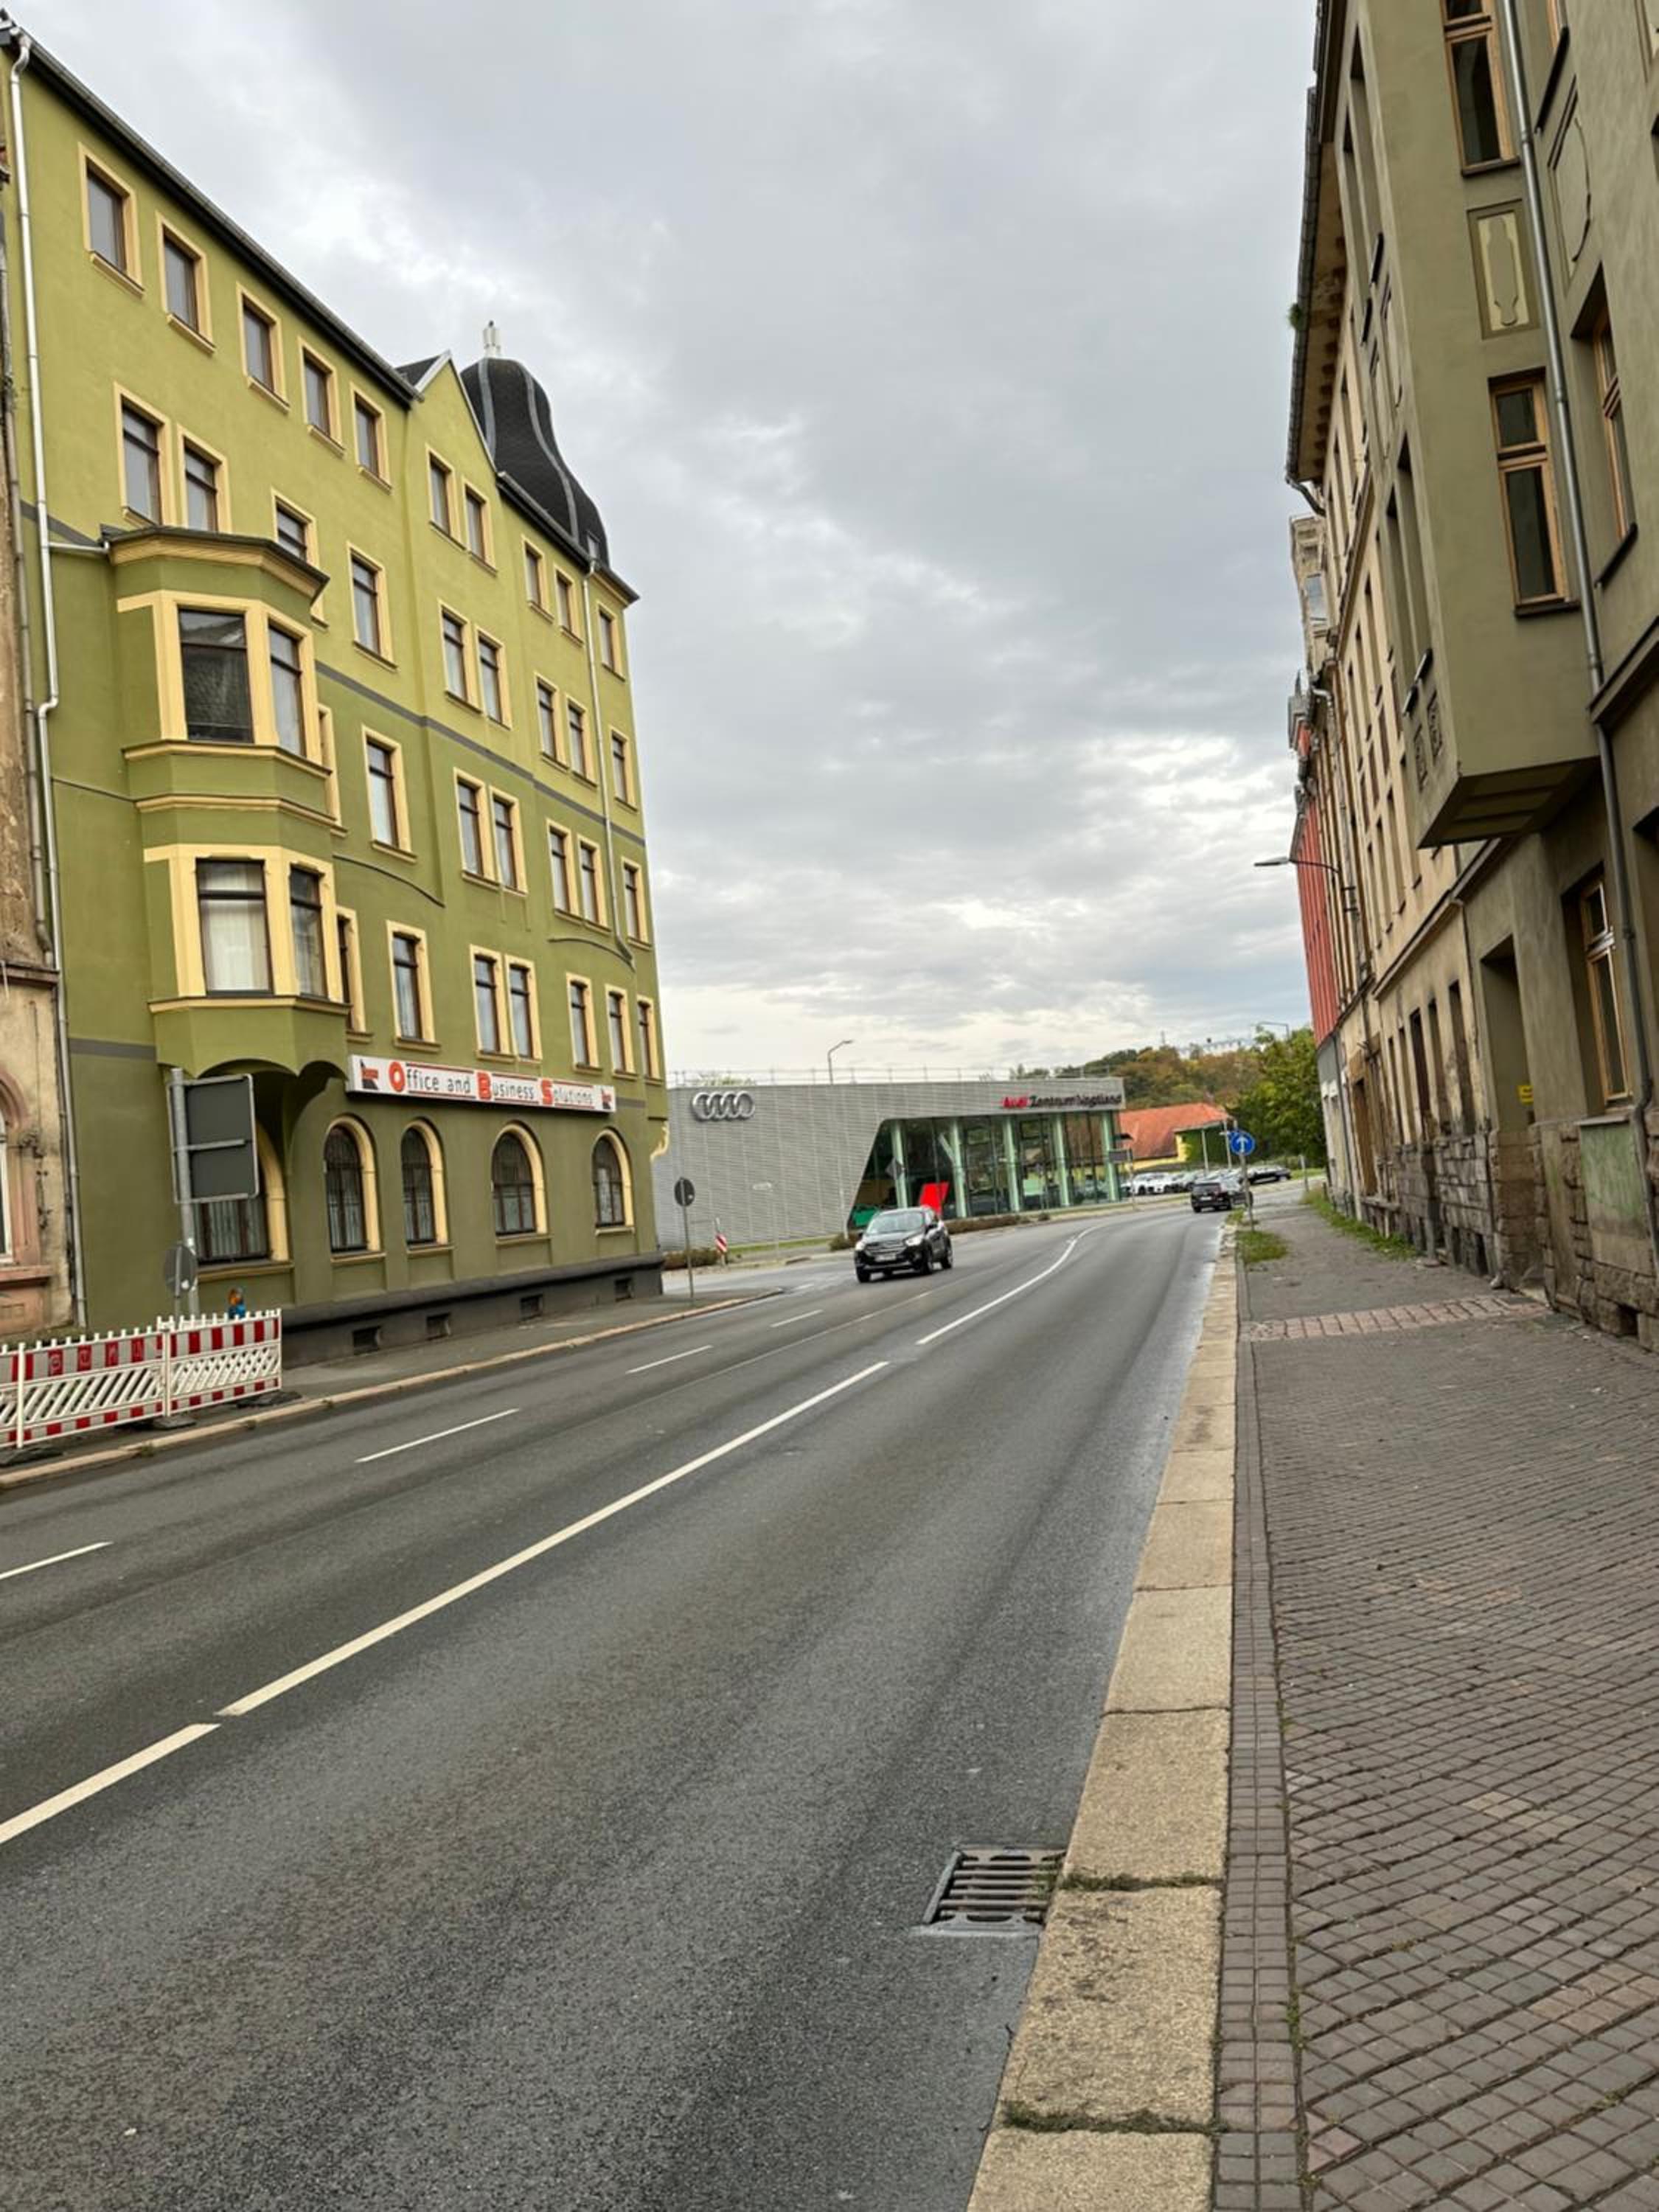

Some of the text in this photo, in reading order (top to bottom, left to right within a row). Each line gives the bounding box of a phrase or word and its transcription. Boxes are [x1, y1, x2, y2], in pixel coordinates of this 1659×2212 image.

[389, 1061, 439, 1093] Office
[448, 1076, 471, 1093] and
[477, 1072, 535, 1100] Business
